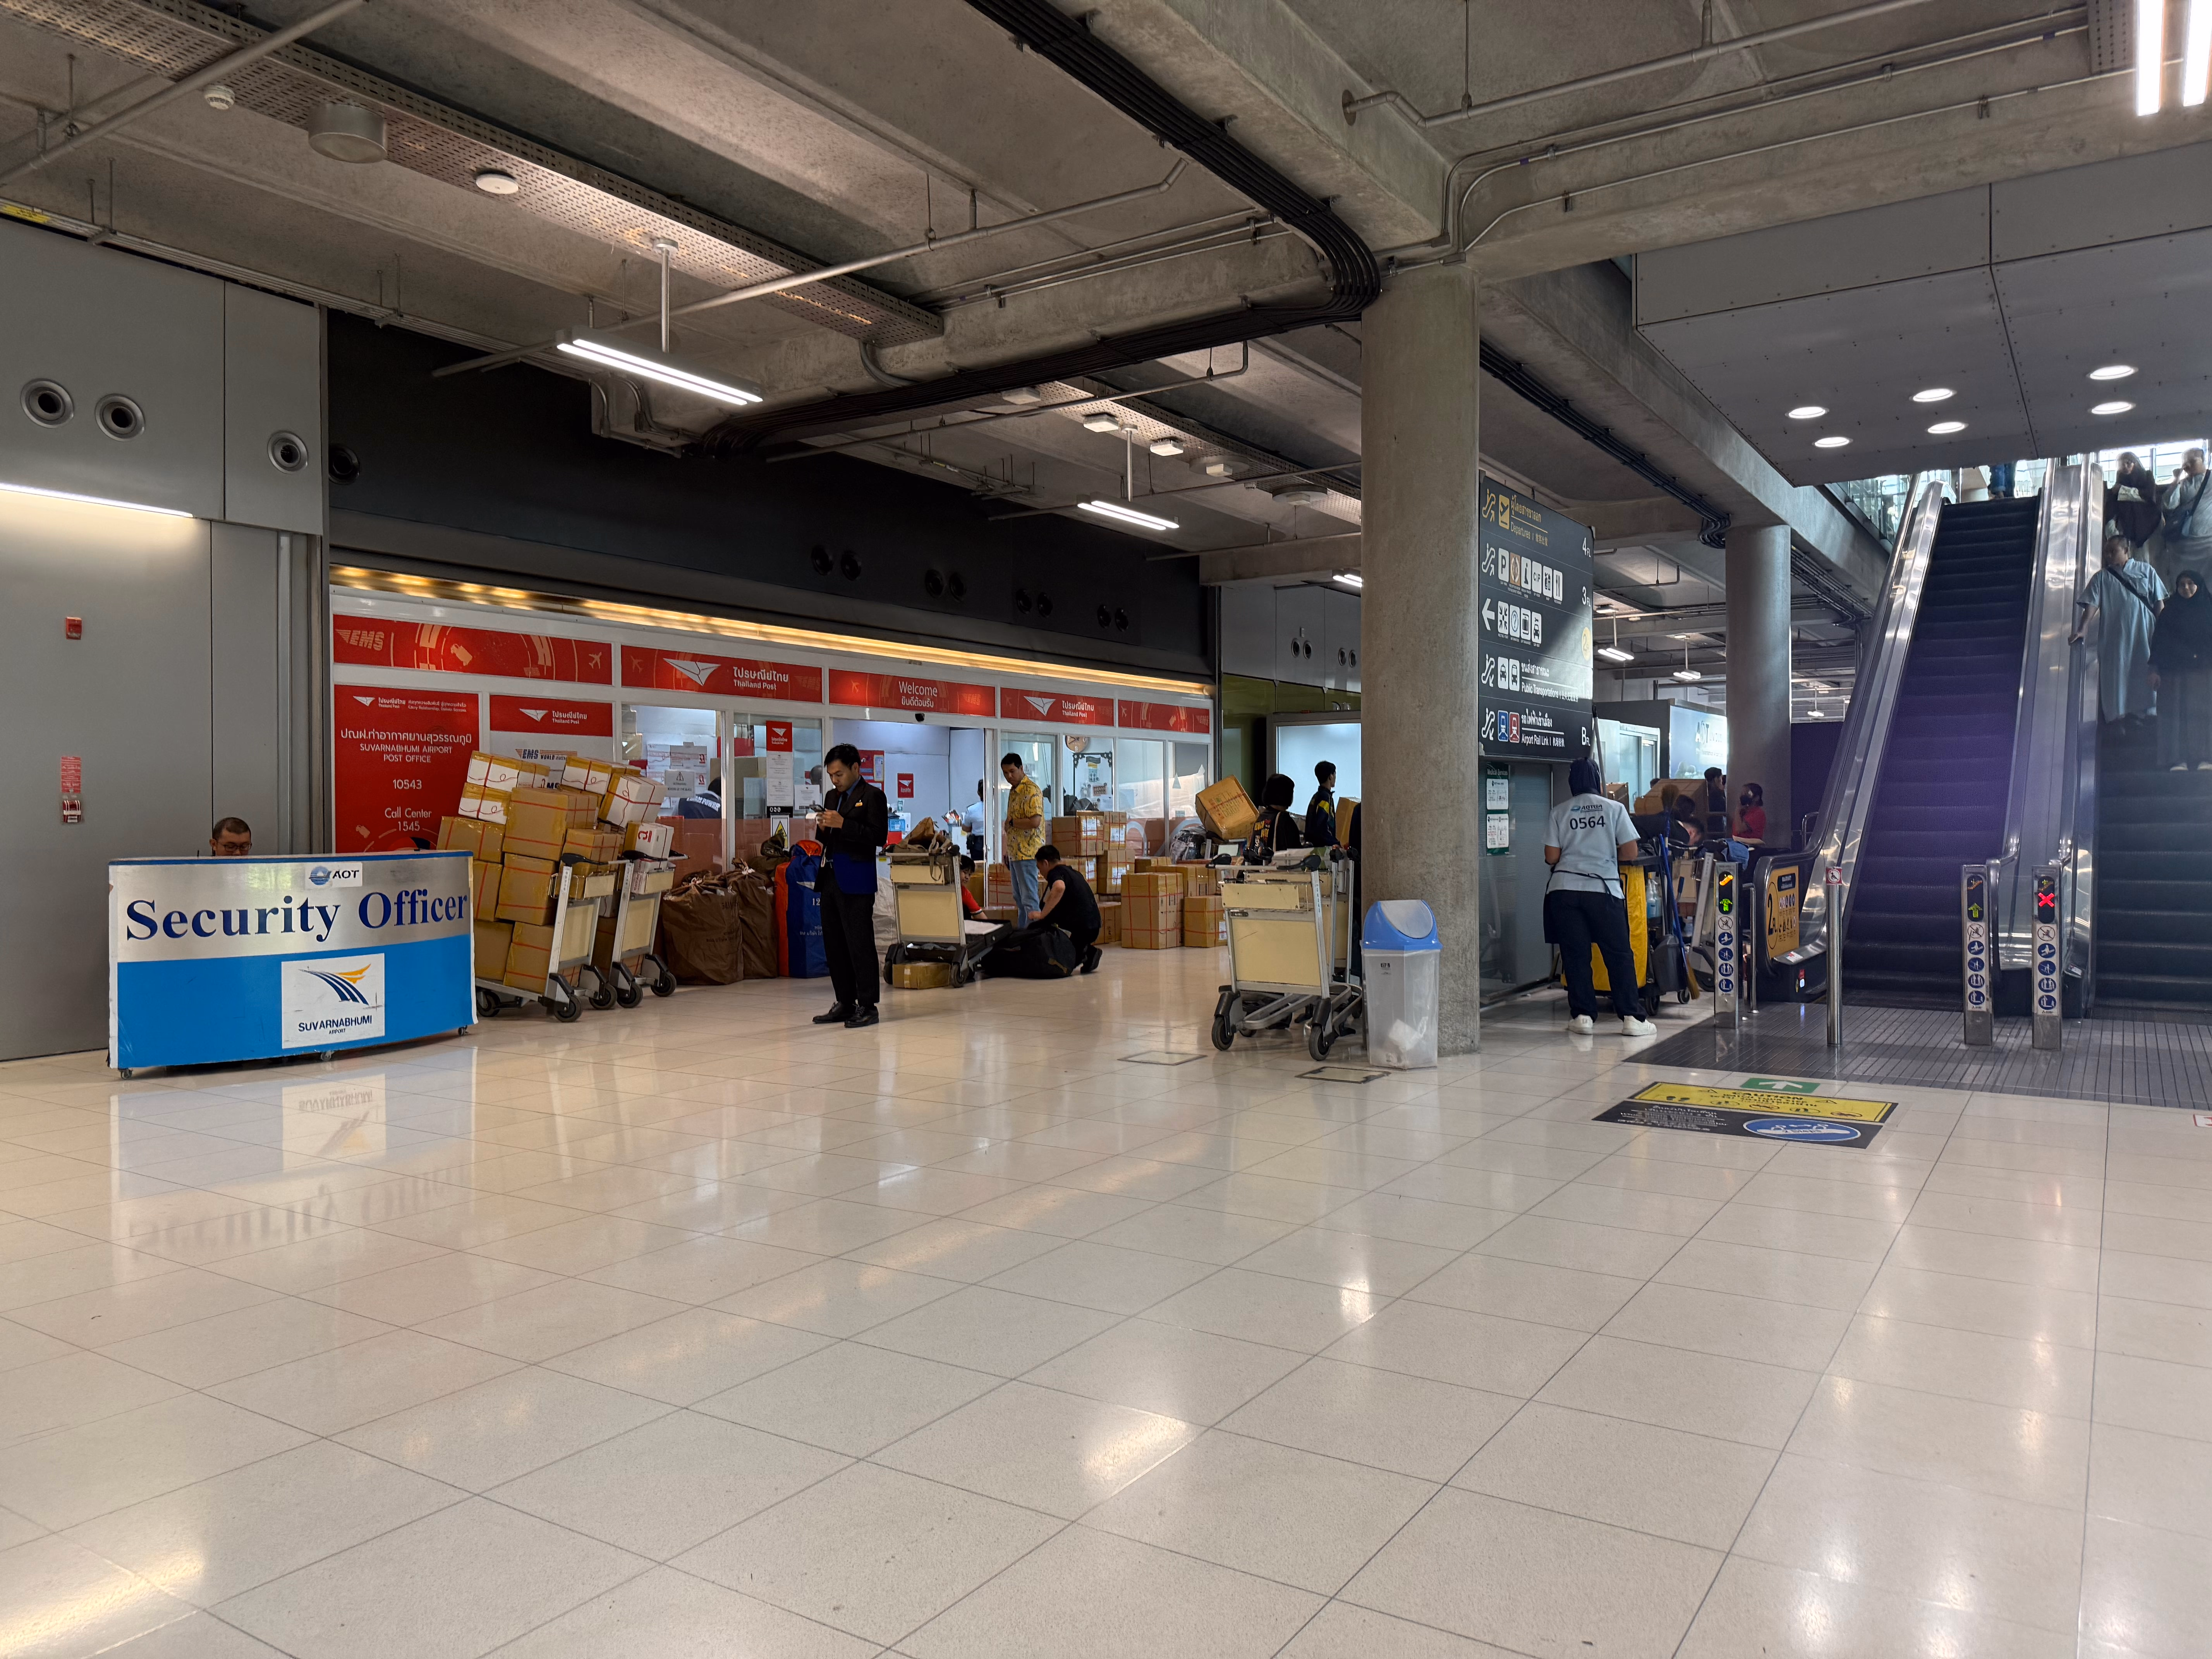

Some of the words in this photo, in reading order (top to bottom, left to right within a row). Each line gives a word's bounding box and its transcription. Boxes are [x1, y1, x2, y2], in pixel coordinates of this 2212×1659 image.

[1511, 522, 1530, 539] Departures
[349, 630, 385, 651] EMS
[733, 666, 789, 682] ไปรษณีย์ไทย
[733, 679, 761, 689] Thailand
[763, 682, 776, 690] Post
[899, 681, 938, 697] Welcome
[1522, 682, 1533, 693] Public
[902, 696, 934, 708] ยินดีต้อนรับ
[1062, 700, 1094, 712] ไปรษณีย์ไทย
[341, 728, 472, 746] ปณฝ.ท่าอากาศยานสุวรรณภูมิ
[1522, 733, 1533, 746] Airport
[360, 743, 419, 753] SUVARNABHUMI
[422, 745, 453, 754] AIRPORT
[522, 749, 539, 759] EMS
[384, 754, 403, 762] POST
[406, 755, 431, 763] OFFICE
[393, 779, 422, 790] 10543
[385, 806, 401, 818] Call
[405, 808, 431, 818] Center
[398, 821, 420, 831] 1545
[1570, 815, 1606, 830] 0564
[332, 869, 360, 880] AOT
[126, 895, 341, 942] Security
[359, 889, 467, 929] Officer
[298, 1015, 372, 1032] SUVARNABHUMI
[1732, 1092, 1803, 1100] CAUTION
